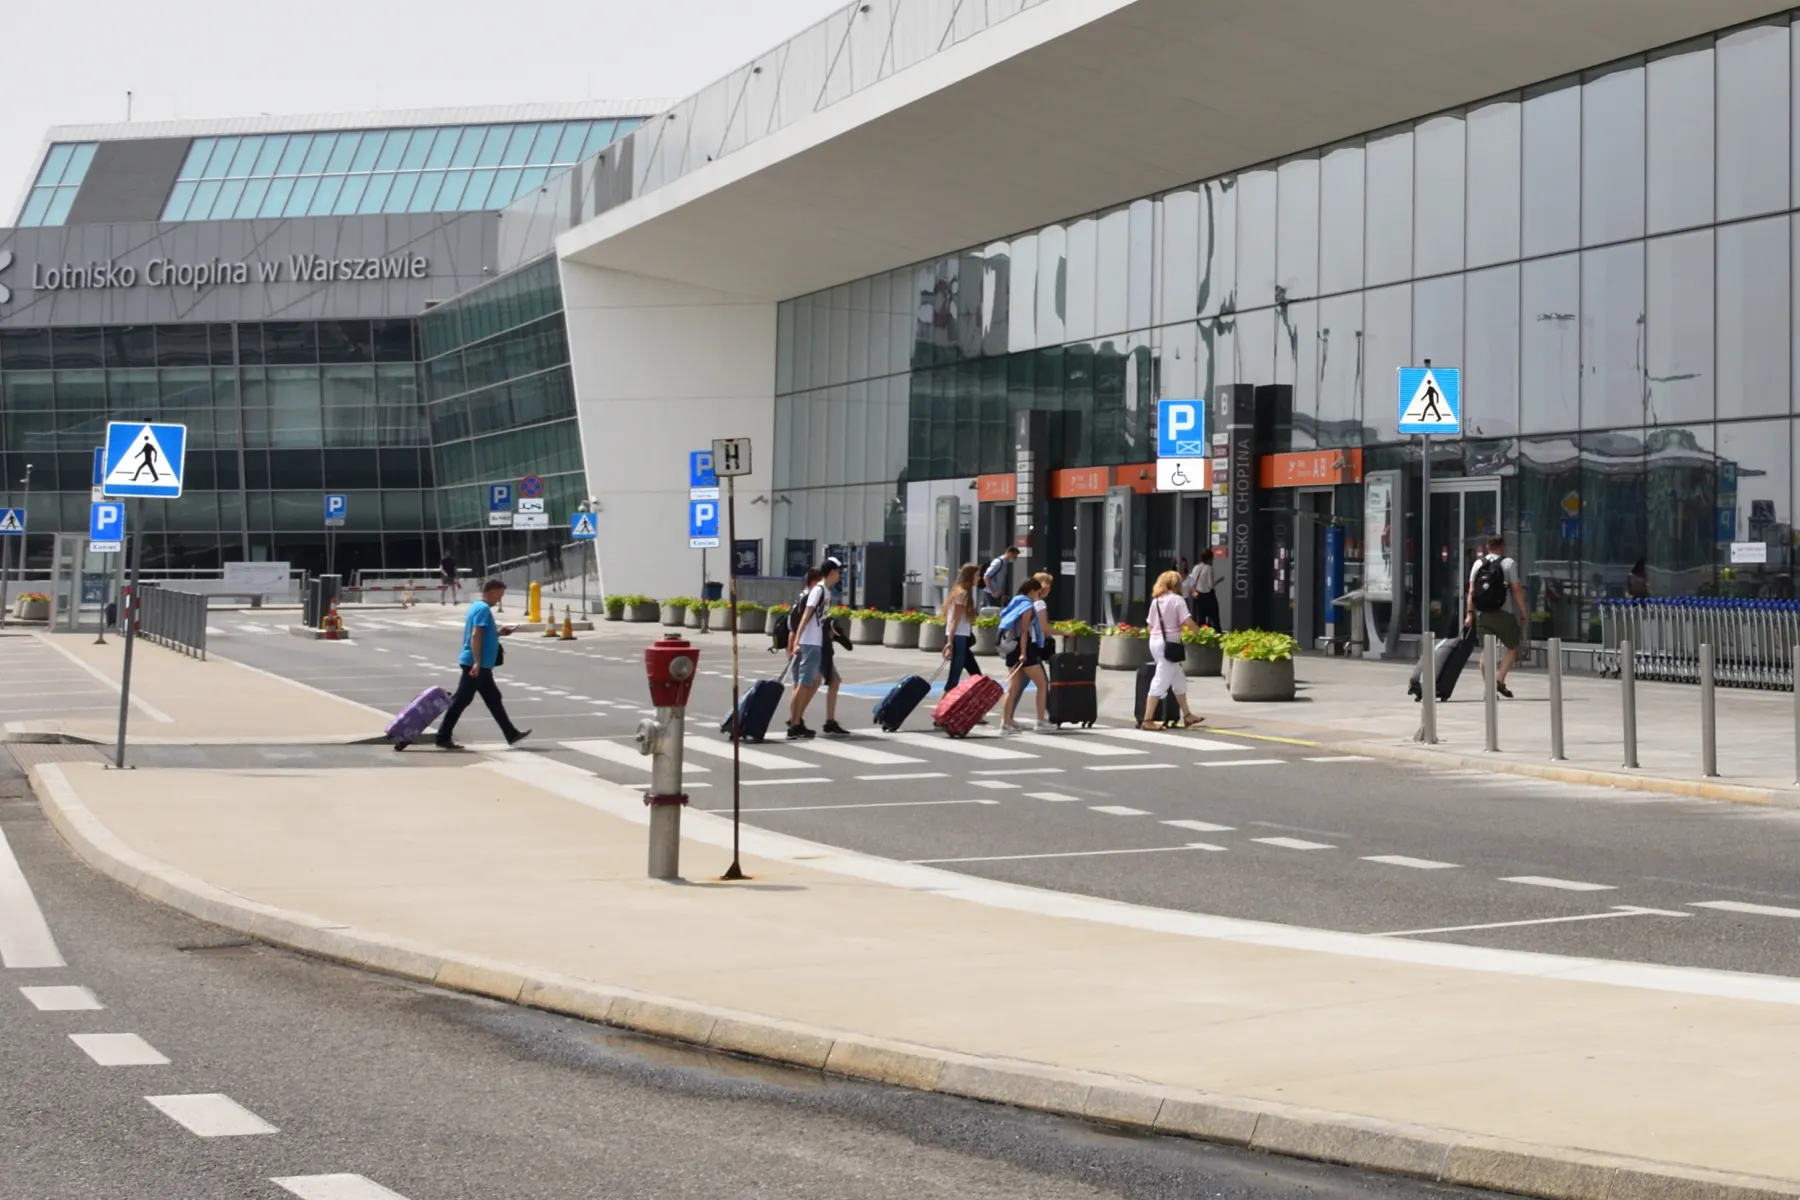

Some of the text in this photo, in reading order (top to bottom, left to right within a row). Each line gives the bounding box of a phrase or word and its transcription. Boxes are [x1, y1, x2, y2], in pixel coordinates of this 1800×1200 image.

[32, 252, 427, 291] Lotnisko Chopina w Warszawie
[1168, 404, 1195, 440] P
[697, 454, 713, 476] P
[725, 443, 740, 470] H
[330, 497, 342, 512] P
[494, 487, 508, 504] P
[98, 506, 118, 530] P
[696, 504, 714, 527] P
[1236, 439, 1249, 599] LOTNISKO CHOPINA
